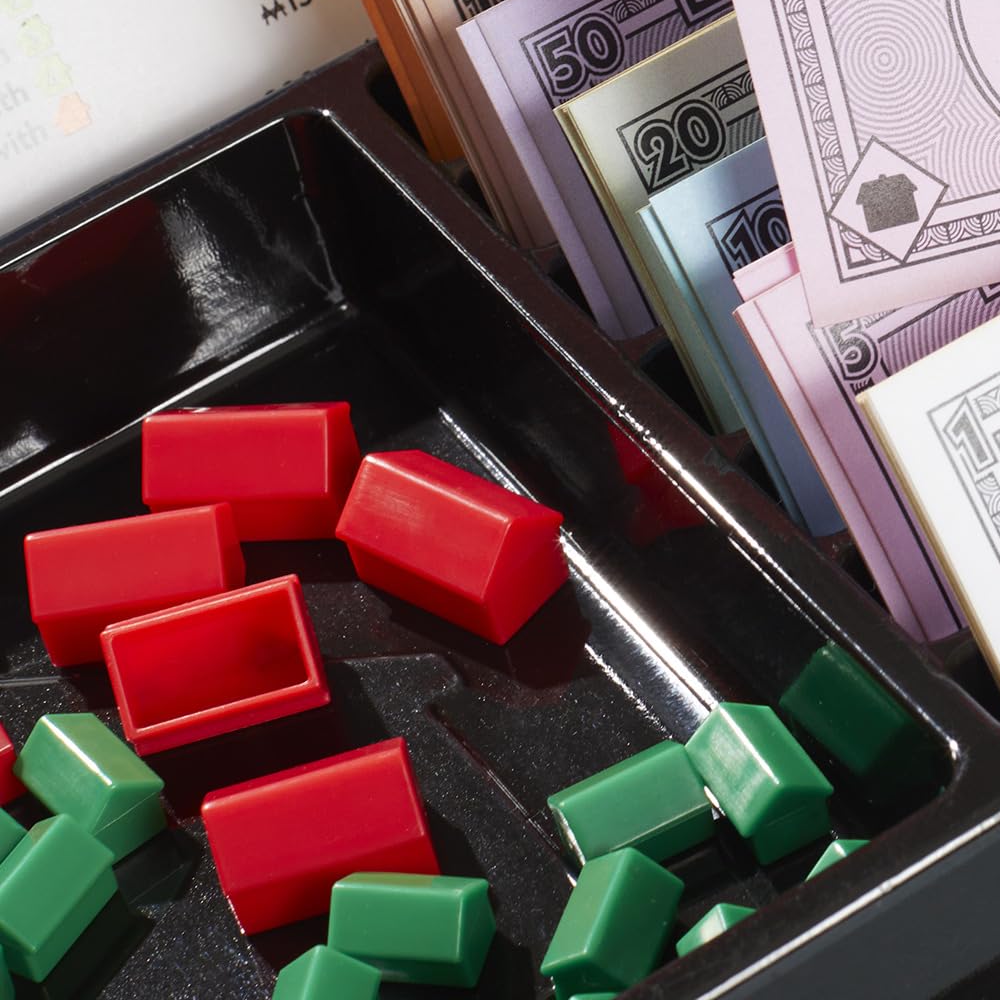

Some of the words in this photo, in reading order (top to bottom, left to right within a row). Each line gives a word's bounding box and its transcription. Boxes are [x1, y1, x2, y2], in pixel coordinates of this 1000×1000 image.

[534, 11, 626, 98] 50
[633, 98, 727, 191] 20
[720, 200, 793, 272] 10
[943, 397, 997, 475] 1
